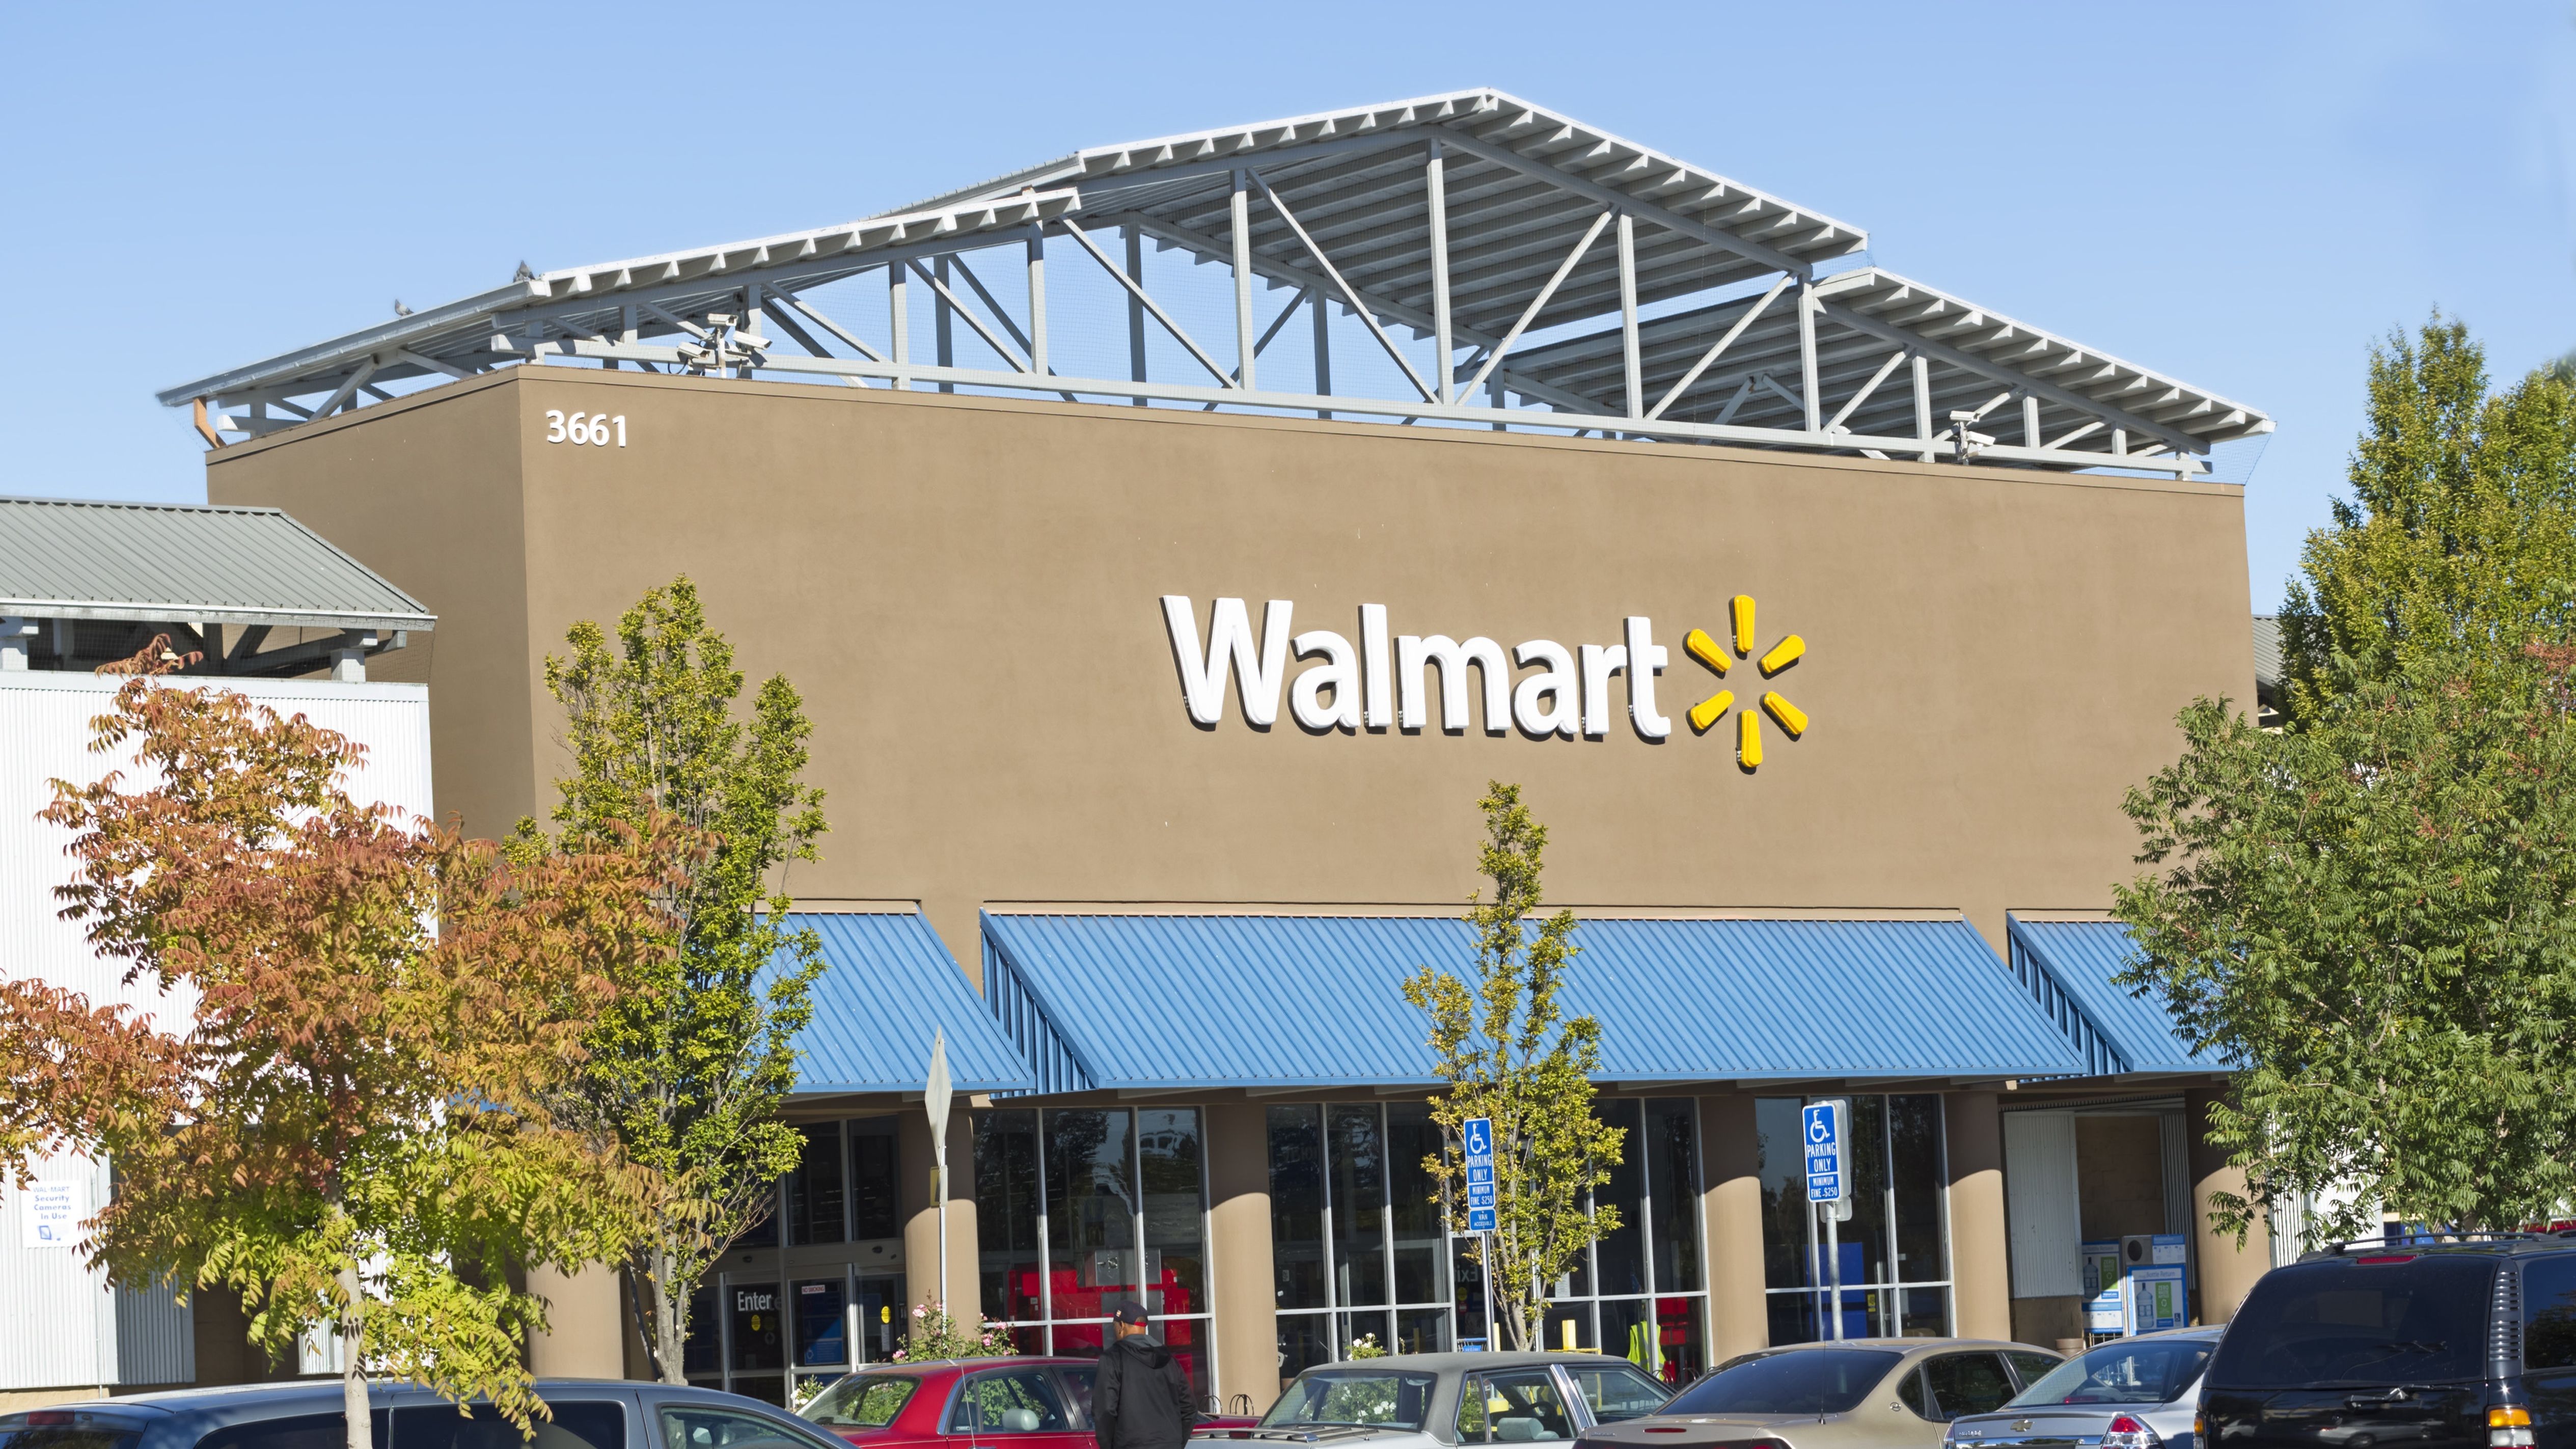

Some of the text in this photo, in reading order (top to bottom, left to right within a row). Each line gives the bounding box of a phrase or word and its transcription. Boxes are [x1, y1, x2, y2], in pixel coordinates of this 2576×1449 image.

[546, 409, 626, 447] 3661
[1162, 594, 1671, 737] Walmart
[1807, 1142, 1835, 1158] PARKING
[1467, 1154, 1492, 1168] PARKING
[1814, 1158, 1831, 1172] ONLY
[1473, 1168, 1488, 1182] ONLY
[1813, 1176, 1834, 1187] MINIMUM
[1472, 1185, 1490, 1195] MINIMUM
[1811, 1187, 1838, 1198] FINE $250
[1470, 1195, 1493, 1205] FINE $250
[737, 1291, 772, 1311] Enter
